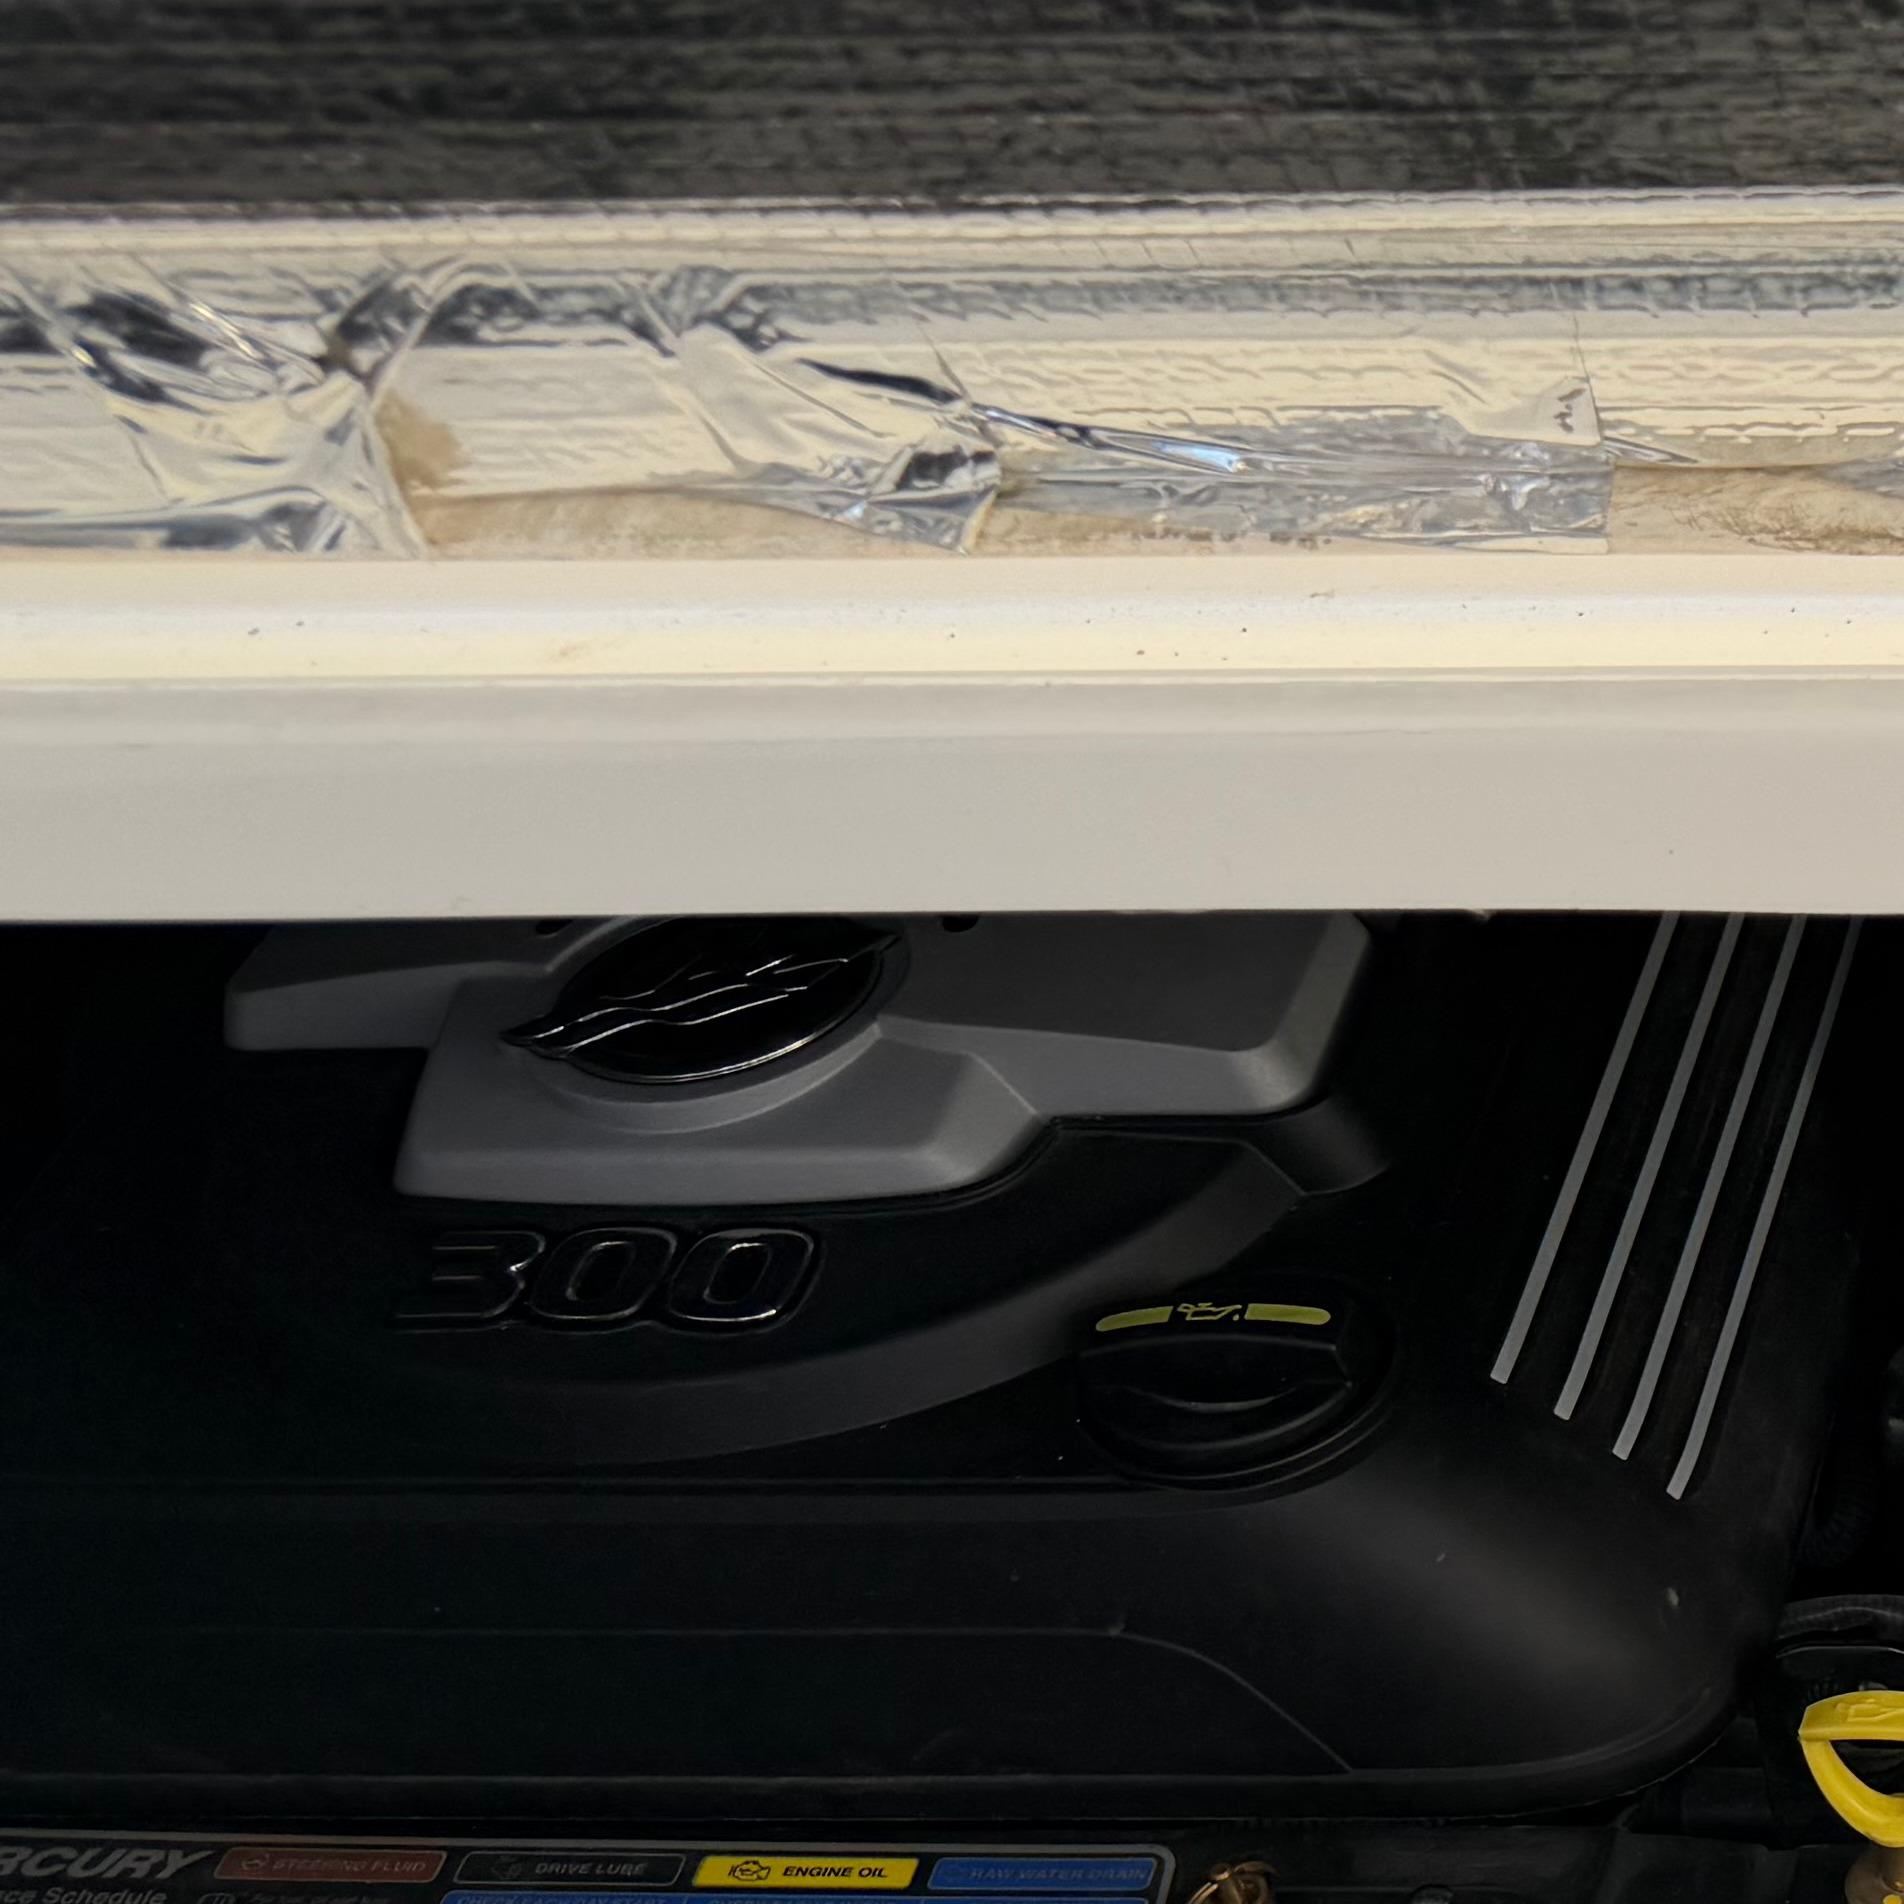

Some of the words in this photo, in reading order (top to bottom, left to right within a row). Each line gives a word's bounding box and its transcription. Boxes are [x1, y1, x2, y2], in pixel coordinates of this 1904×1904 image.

[396, 1228, 818, 1335] 300
[535, 1862, 594, 1875] DRIVE
[596, 1862, 648, 1875] LUBE
[783, 1866, 853, 1878] ENGINE
[859, 1867, 888, 1878] OIL
